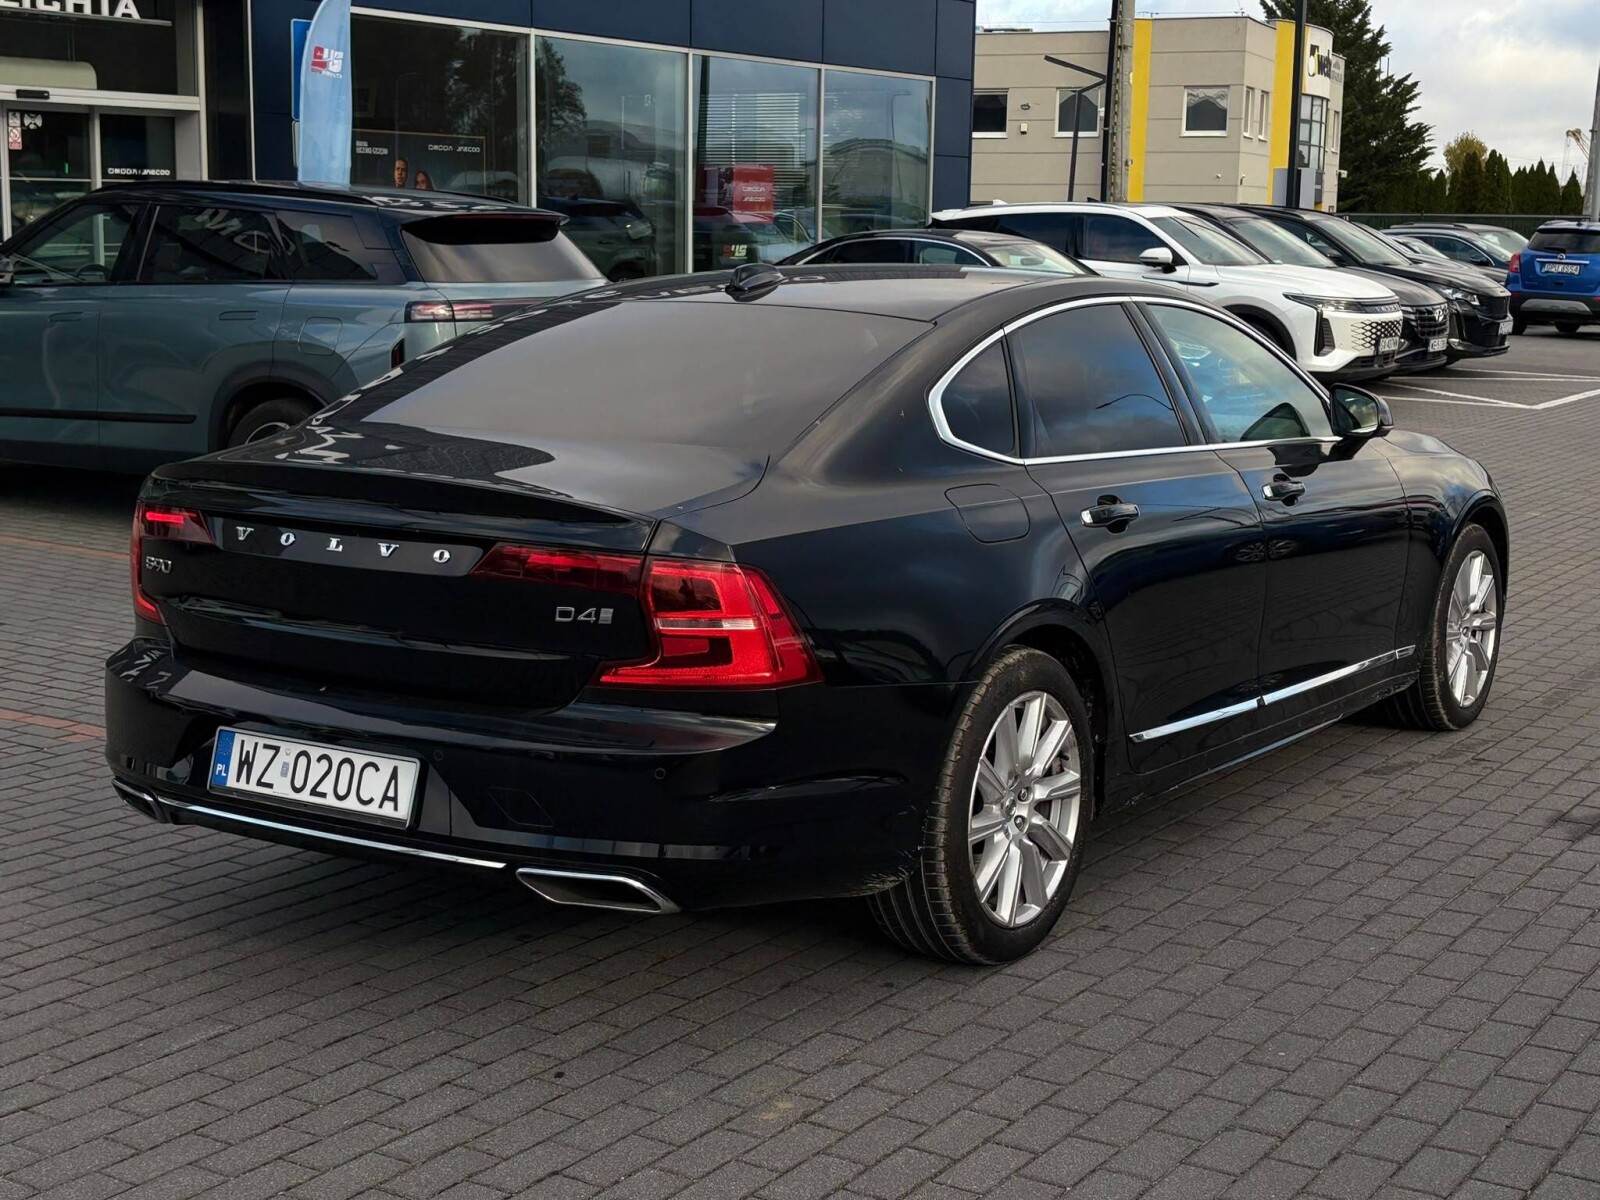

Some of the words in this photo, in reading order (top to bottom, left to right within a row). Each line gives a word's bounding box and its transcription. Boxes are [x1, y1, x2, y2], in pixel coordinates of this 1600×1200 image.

[236, 526, 450, 563] VOLVO
[145, 556, 172, 574] S90
[555, 606, 596, 624] D4
[216, 763, 227, 776] PL
[236, 739, 281, 789] WZ
[290, 750, 399, 812] 020CA
